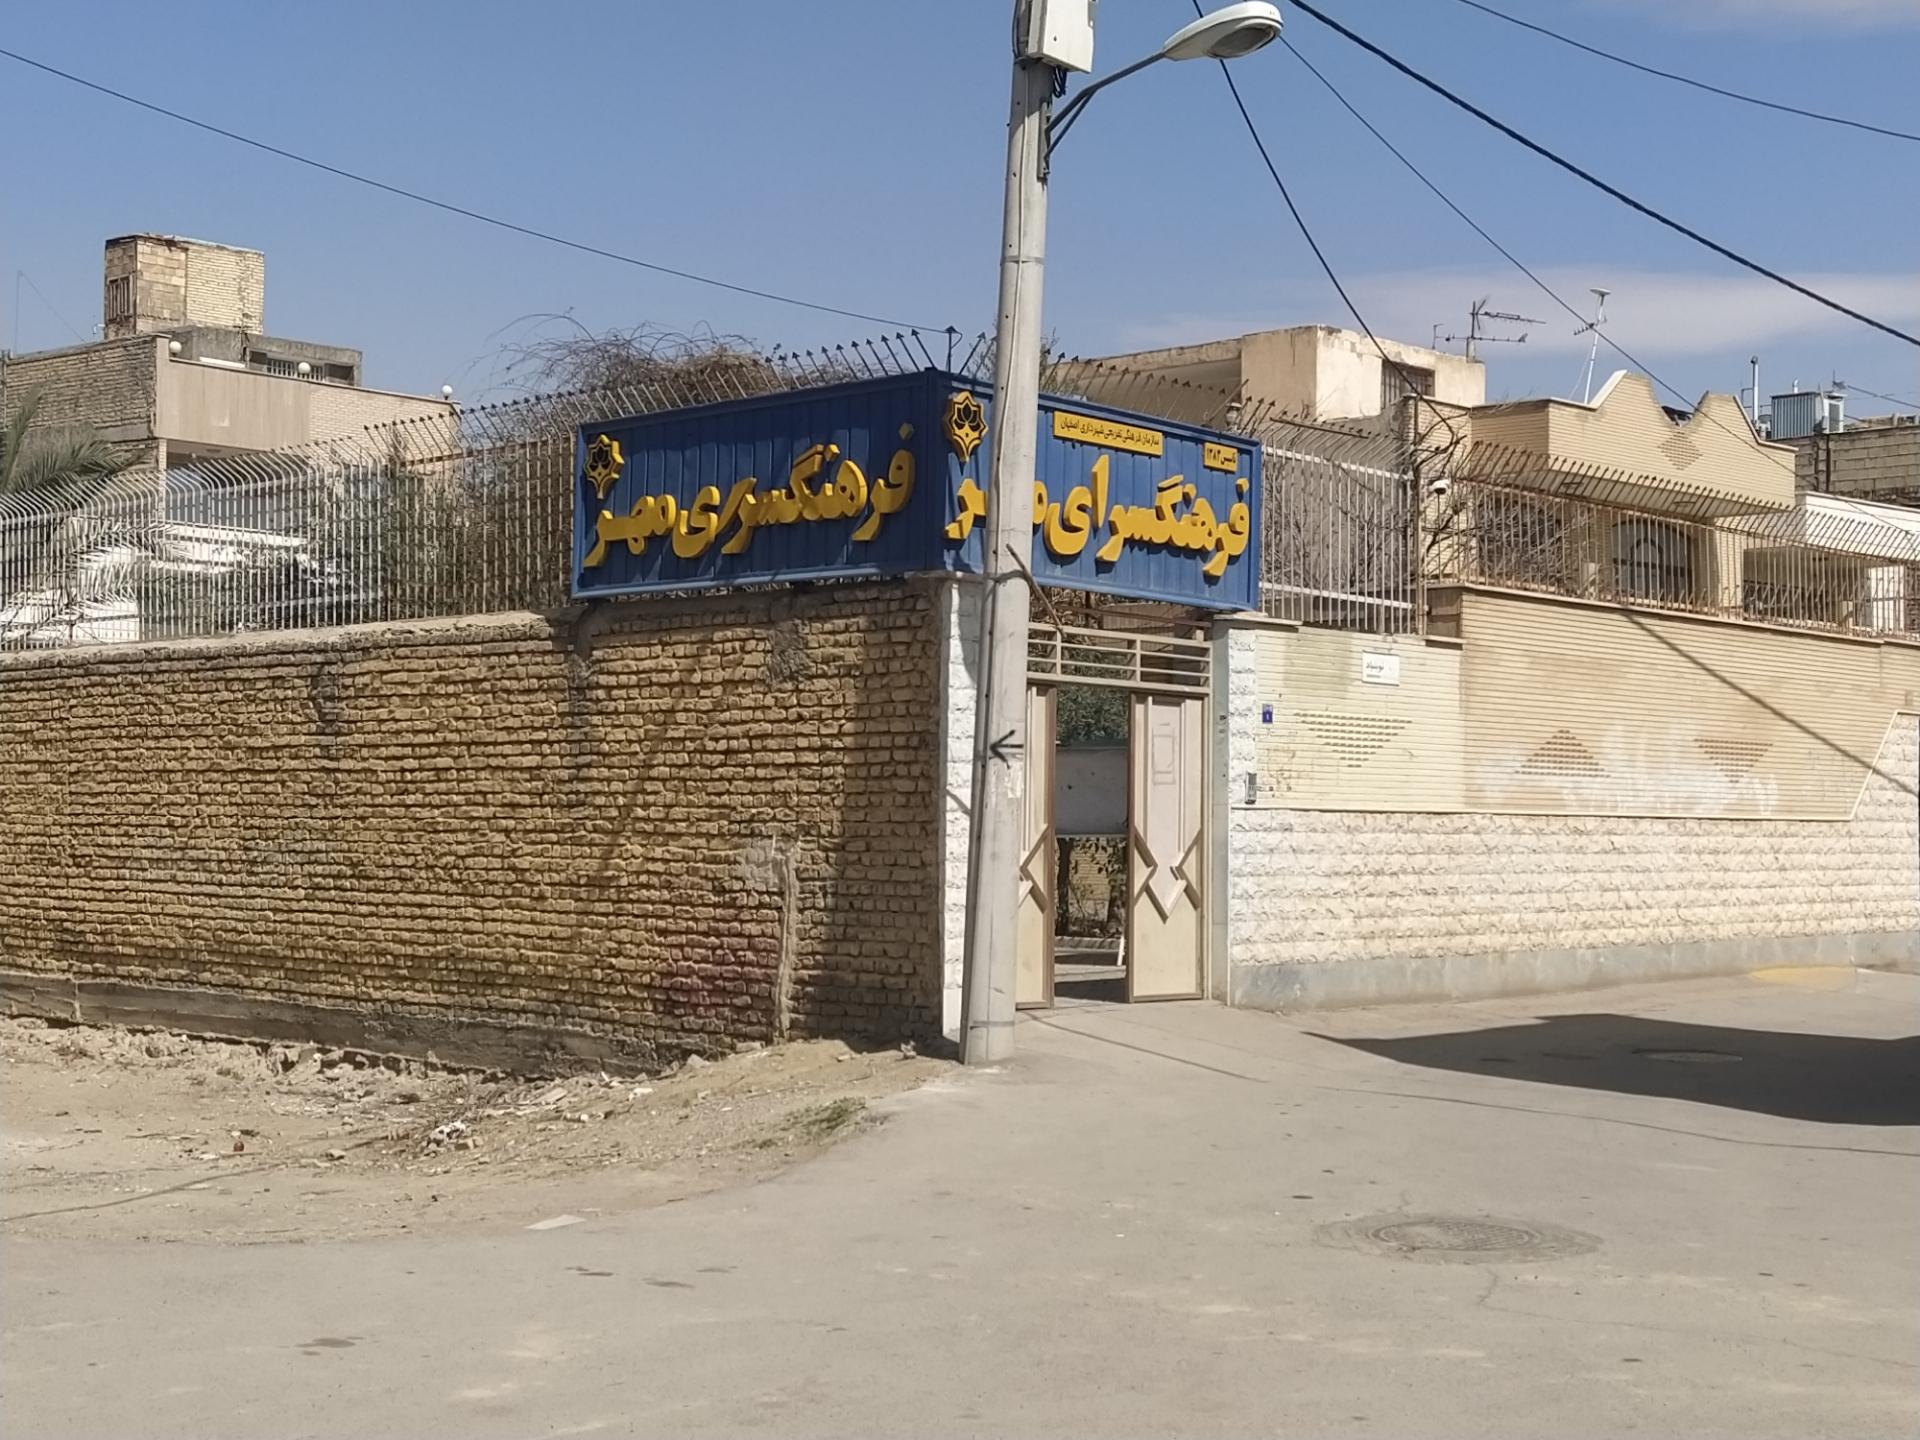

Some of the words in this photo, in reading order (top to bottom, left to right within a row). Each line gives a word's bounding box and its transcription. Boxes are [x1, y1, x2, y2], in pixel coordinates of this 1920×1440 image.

[583, 494, 676, 568] مهر
[672, 423, 915, 558] فرهنگسرای
[944, 478, 1048, 540] مر
[1043, 454, 1250, 577] فرهنگسرای
